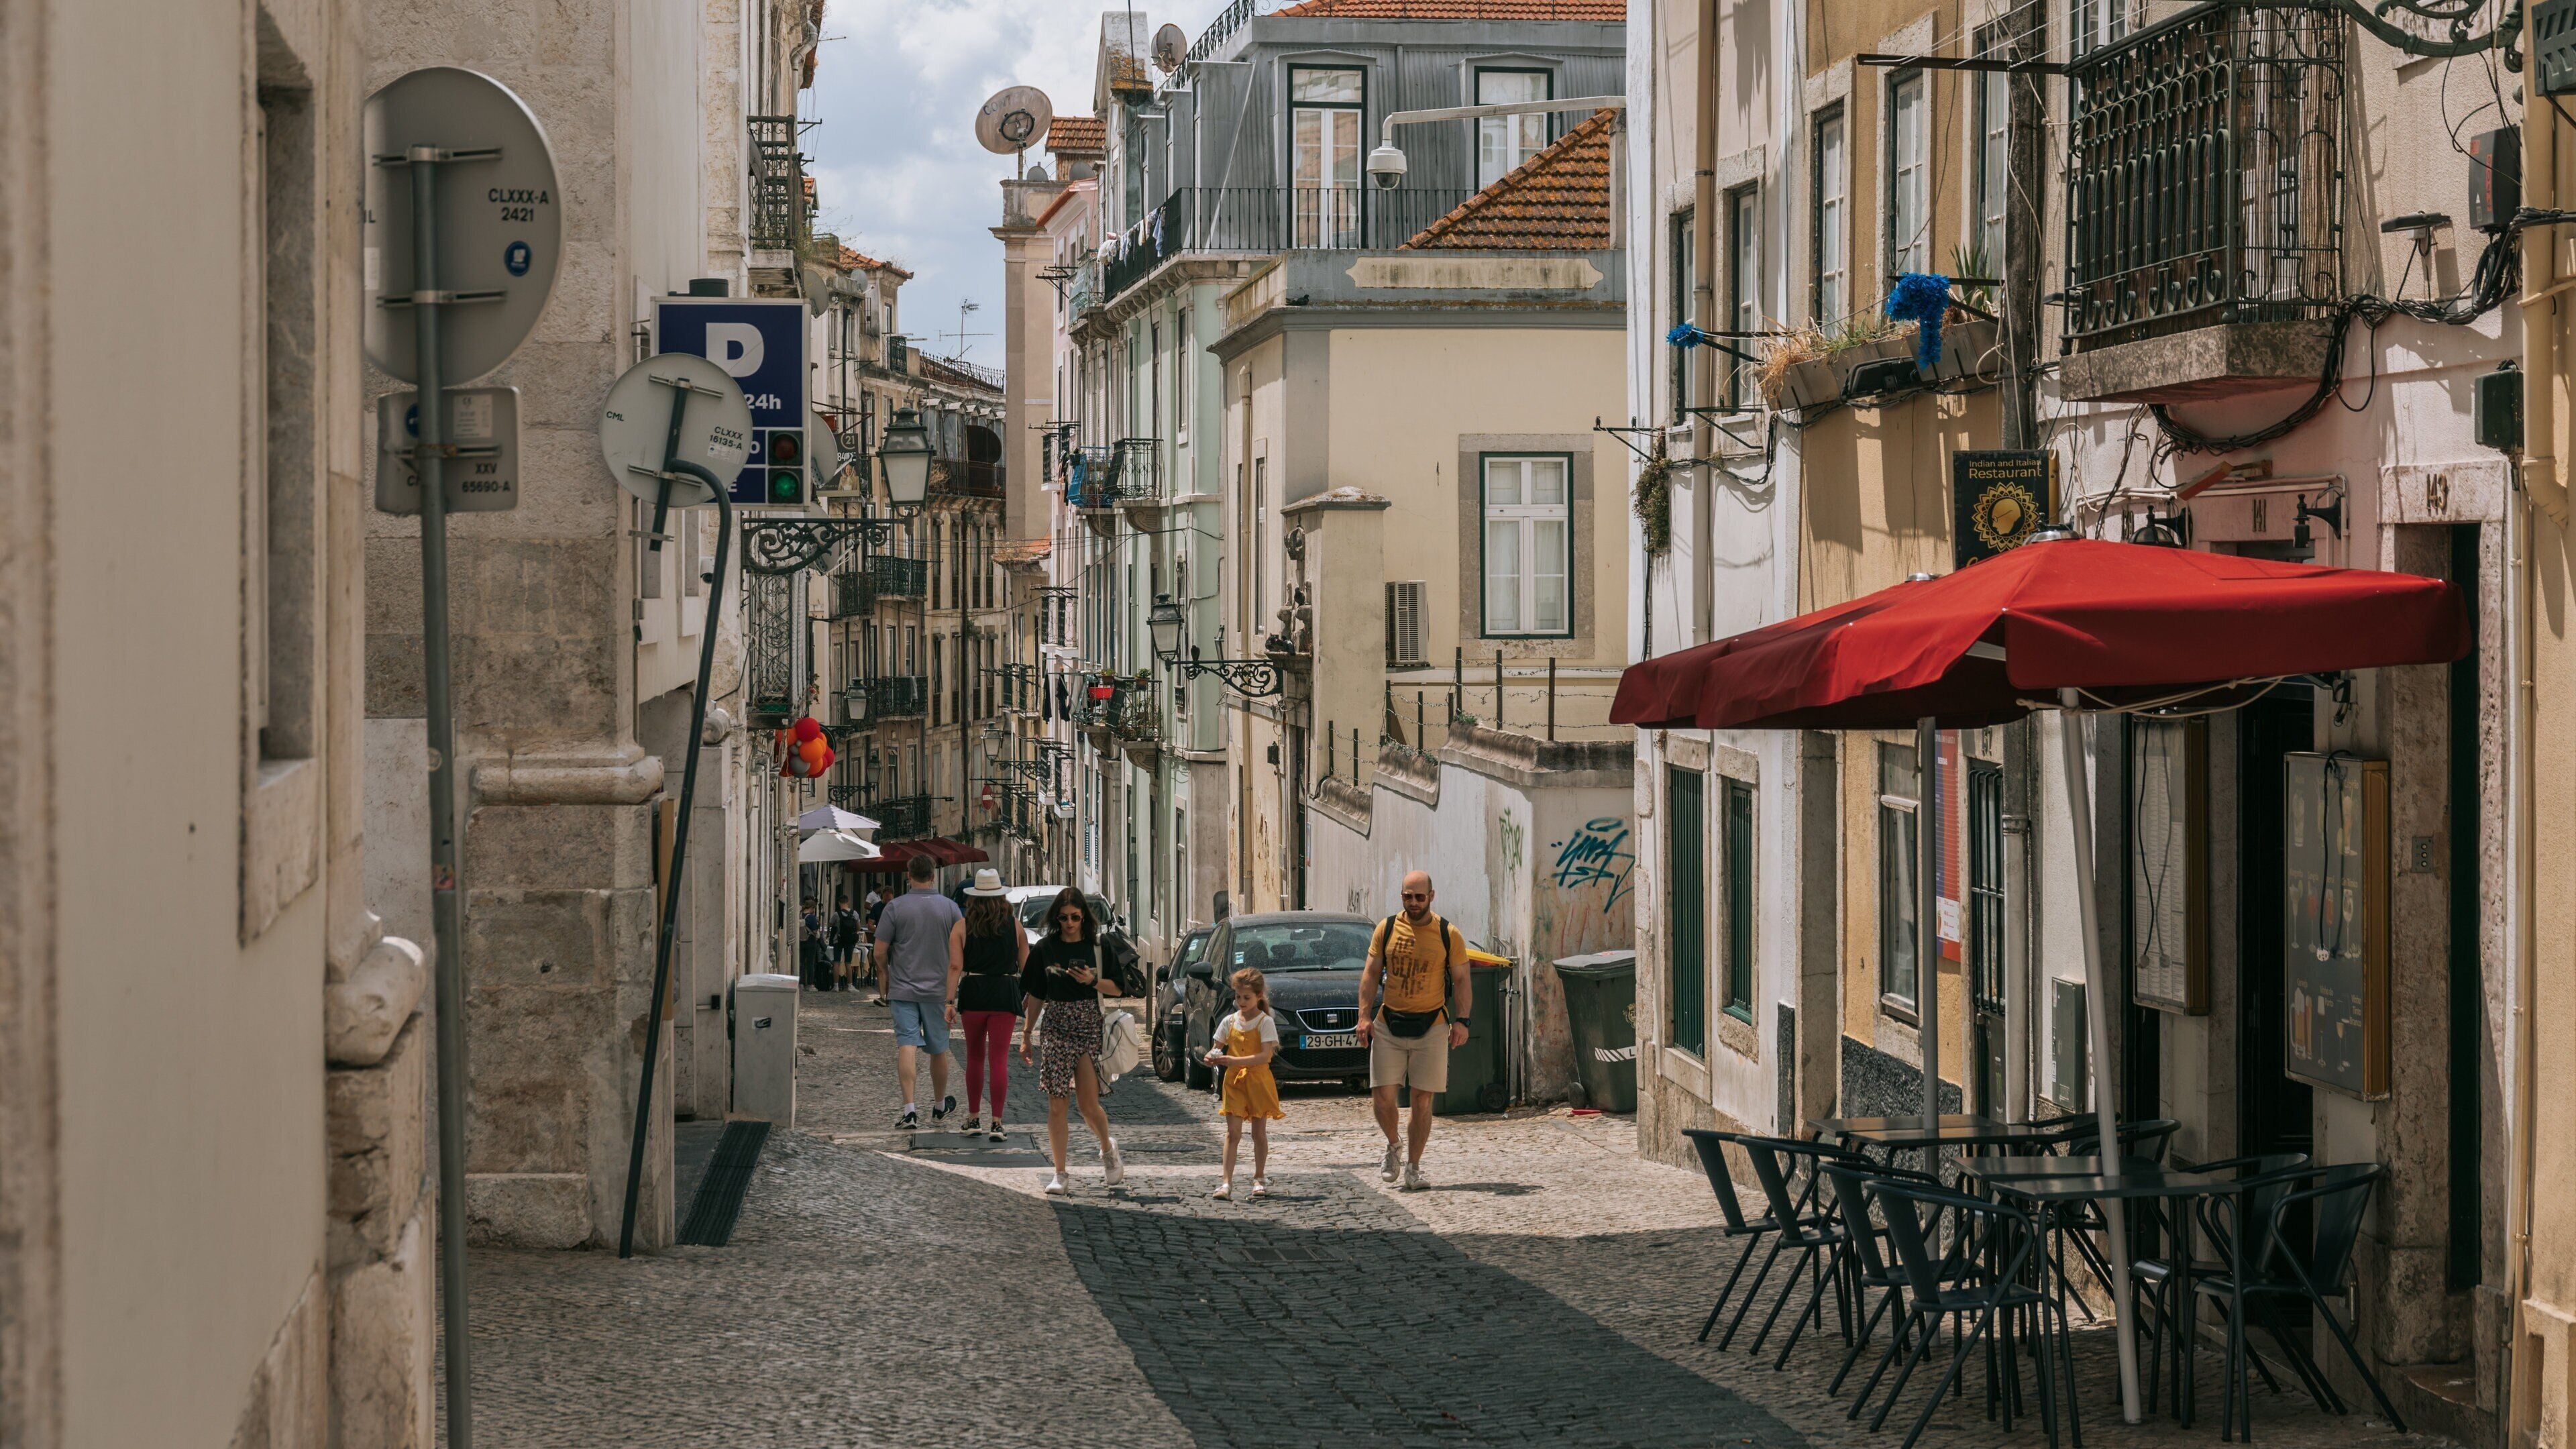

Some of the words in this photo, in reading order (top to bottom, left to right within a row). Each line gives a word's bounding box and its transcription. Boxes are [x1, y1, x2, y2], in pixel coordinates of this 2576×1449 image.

[488, 189, 549, 205] CLXXX-A
[501, 207, 534, 221] 2421
[606, 411, 625, 422] CML
[714, 425, 744, 441] CLXXX
[709, 434, 743, 451] 16135-A
[475, 463, 498, 474] XXV
[1969, 460, 1996, 468] Indian
[1998, 459, 2014, 468] and
[2016, 458, 2042, 466] Italian
[1969, 468, 2043, 479] Restaurant
[462, 480, 511, 493] 65690-A
[2426, 473, 2449, 511] 143
